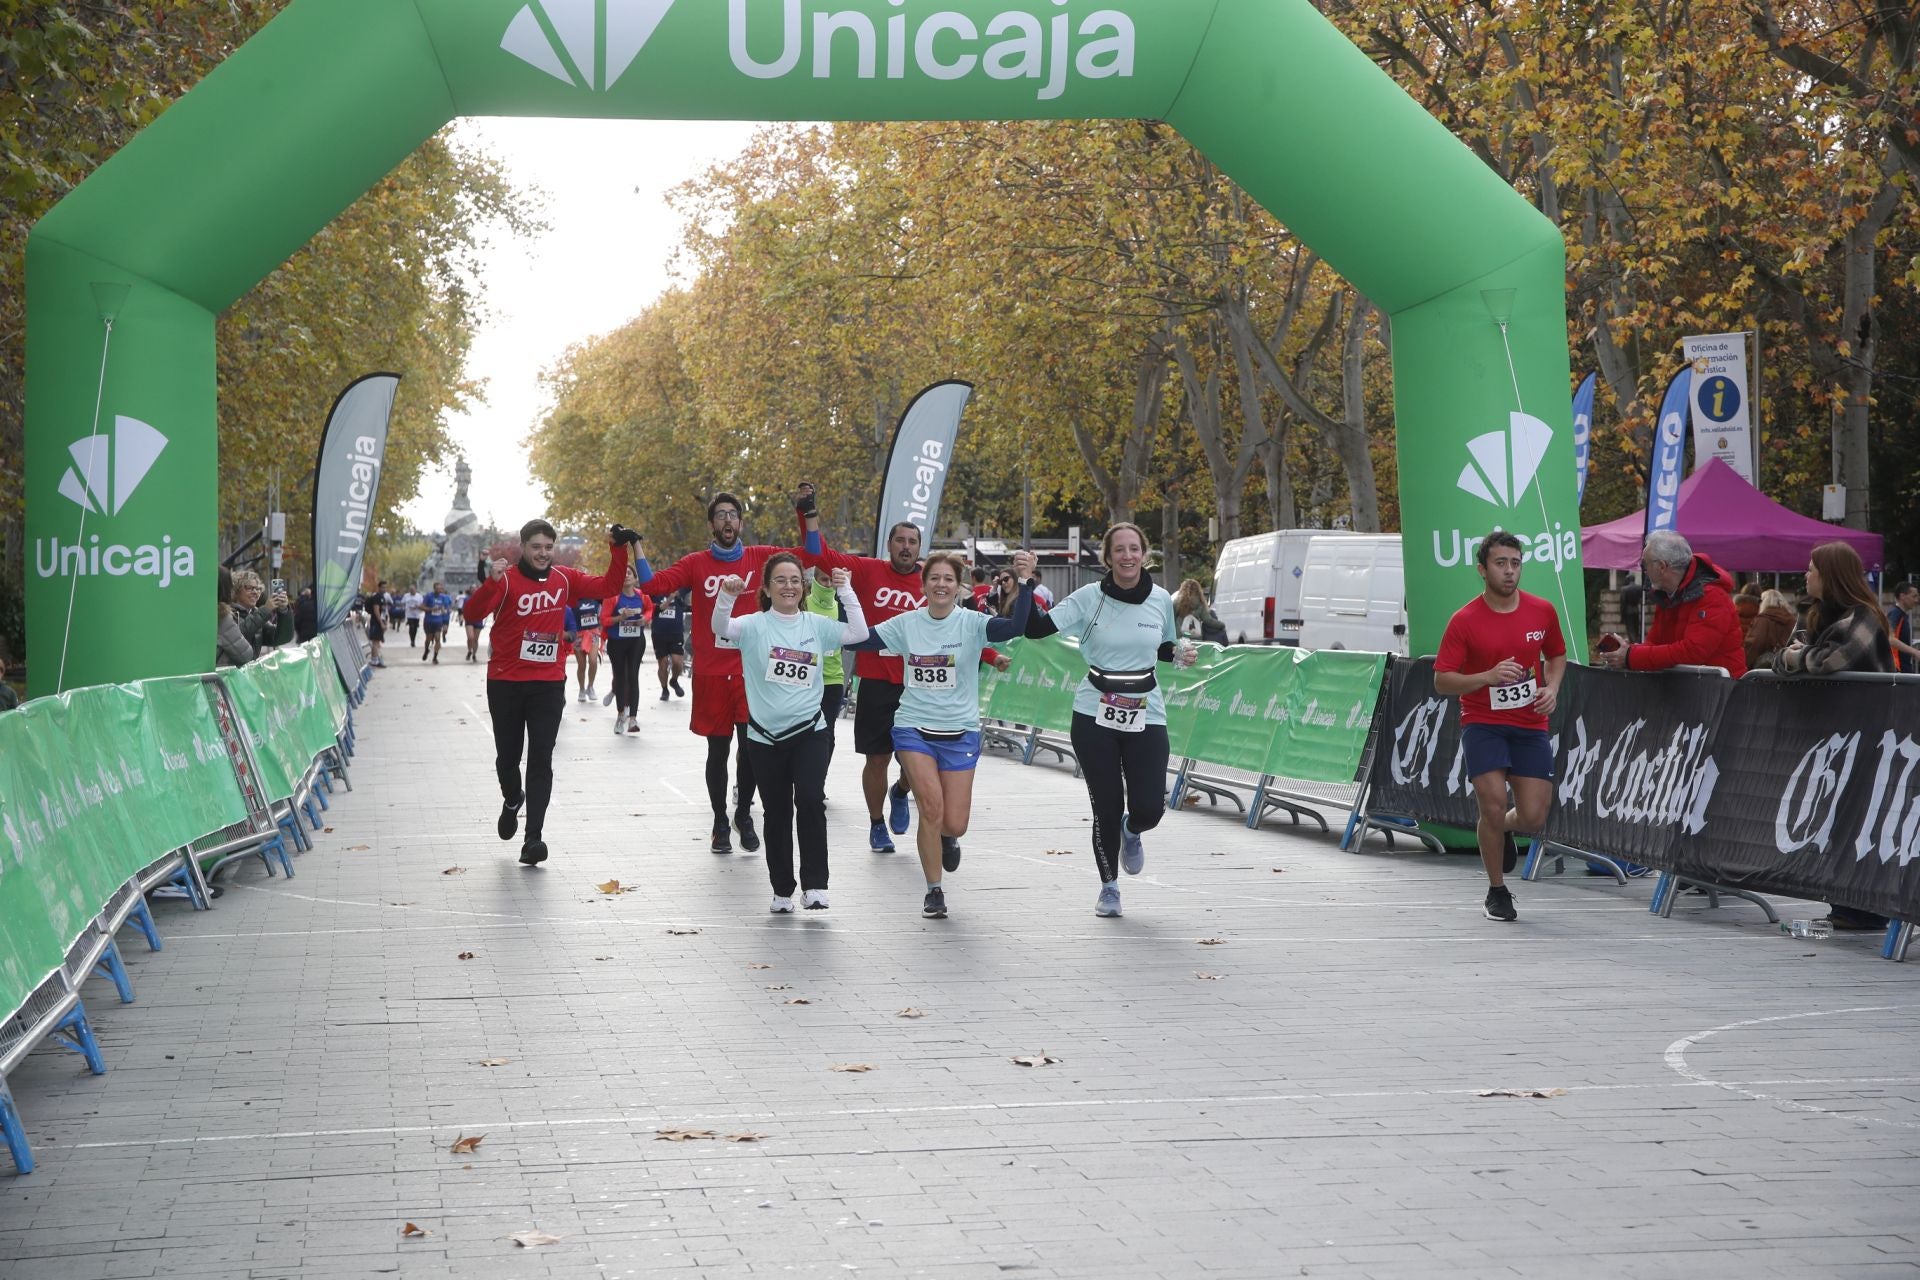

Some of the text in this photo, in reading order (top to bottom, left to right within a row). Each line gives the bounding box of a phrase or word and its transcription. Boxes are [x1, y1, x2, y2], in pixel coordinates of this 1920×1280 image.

[728, 0, 1137, 100] Unicaja
[1691, 343, 1729, 352] Oficina de
[1693, 352, 1738, 362] Irmación
[1695, 365, 1727, 374] rística
[1655, 412, 1682, 528] VECO
[337, 435, 380, 554] Unicaja
[903, 439, 945, 532] nicaja
[1433, 521, 1577, 573] Uncaja
[36, 534, 194, 588] Unicaja
[517, 588, 563, 616] gmv
[623, 625, 637, 634] 994
[526, 643, 554, 657] 420
[773, 661, 809, 680] 836
[913, 667, 948, 683] 838
[1496, 683, 1531, 702] 333
[1104, 706, 1139, 725] 837
[1391, 696, 1449, 789] El
[1559, 715, 1602, 811] de
[1596, 716, 1721, 836] Castilla
[1775, 730, 1862, 855] El
